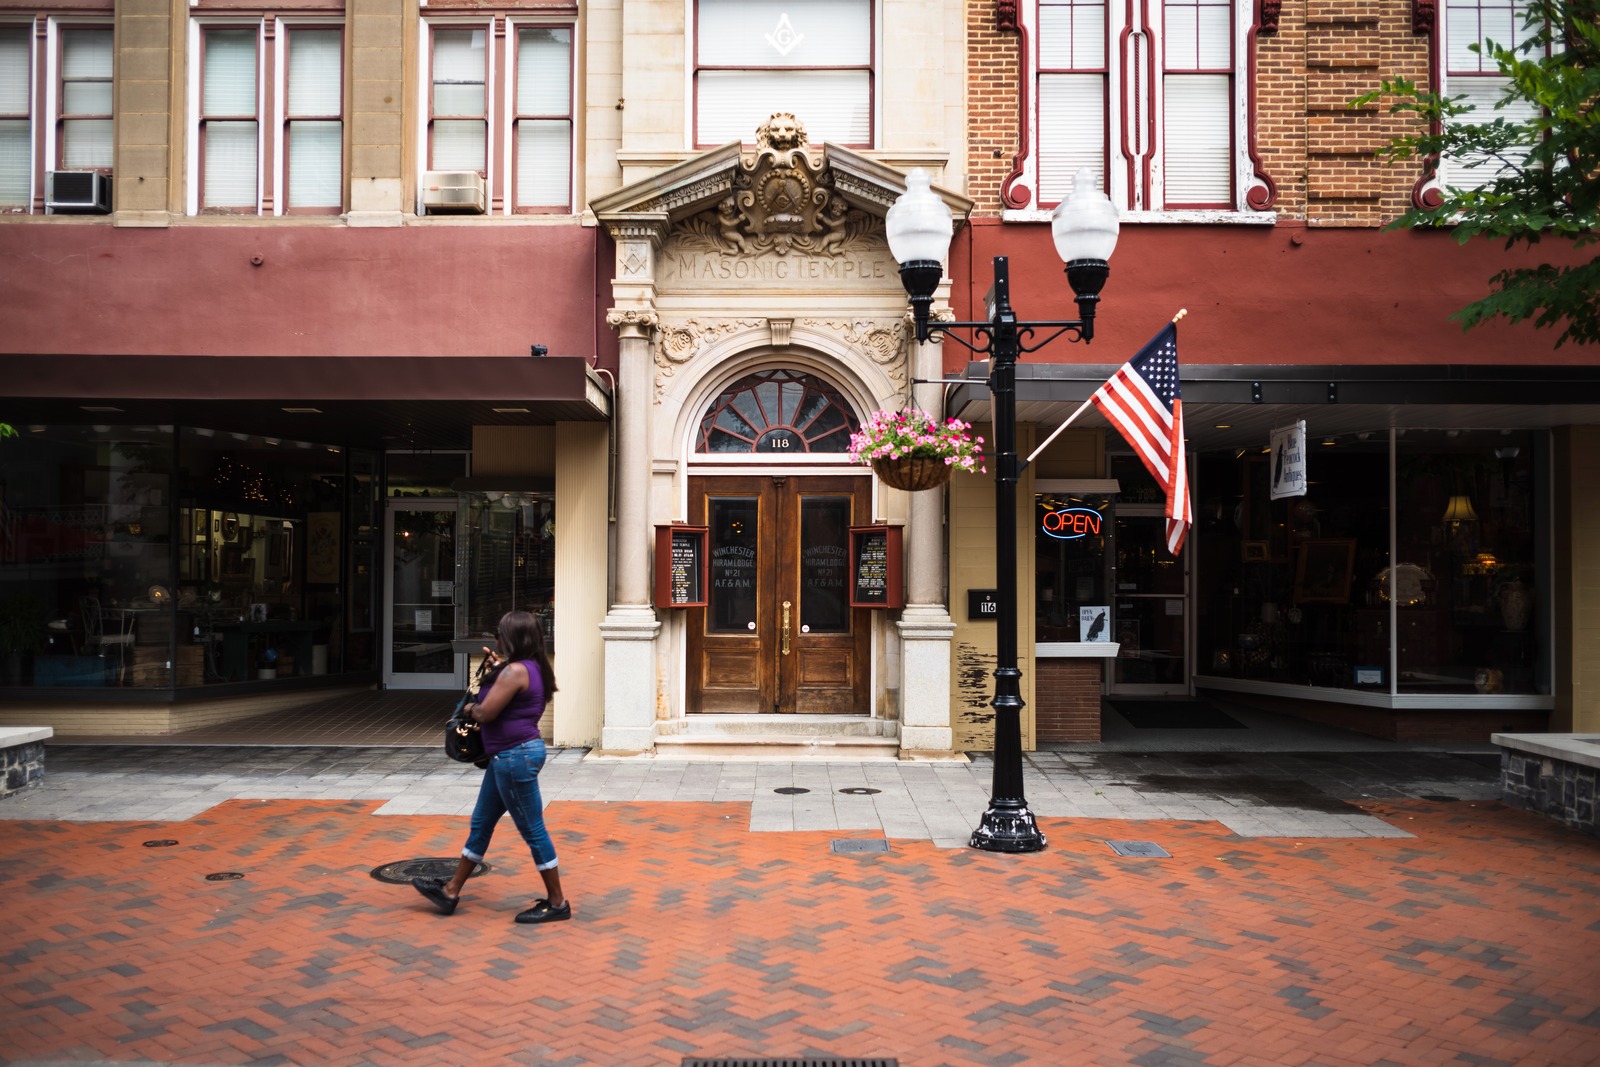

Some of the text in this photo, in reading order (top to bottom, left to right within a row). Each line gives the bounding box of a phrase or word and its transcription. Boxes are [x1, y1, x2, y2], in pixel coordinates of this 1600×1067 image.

[777, 29, 791, 45] G
[678, 252, 885, 279] MASONIC TEMPLE
[772, 438, 790, 448] 118
[1043, 511, 1101, 534] OPEN
[712, 546, 755, 558] WINCHESTER
[806, 545, 847, 557] WINCHESTER
[713, 559, 753, 567] HIRAM LODGE
[806, 558, 825, 567] HIRAM
[981, 602, 997, 612] 116
